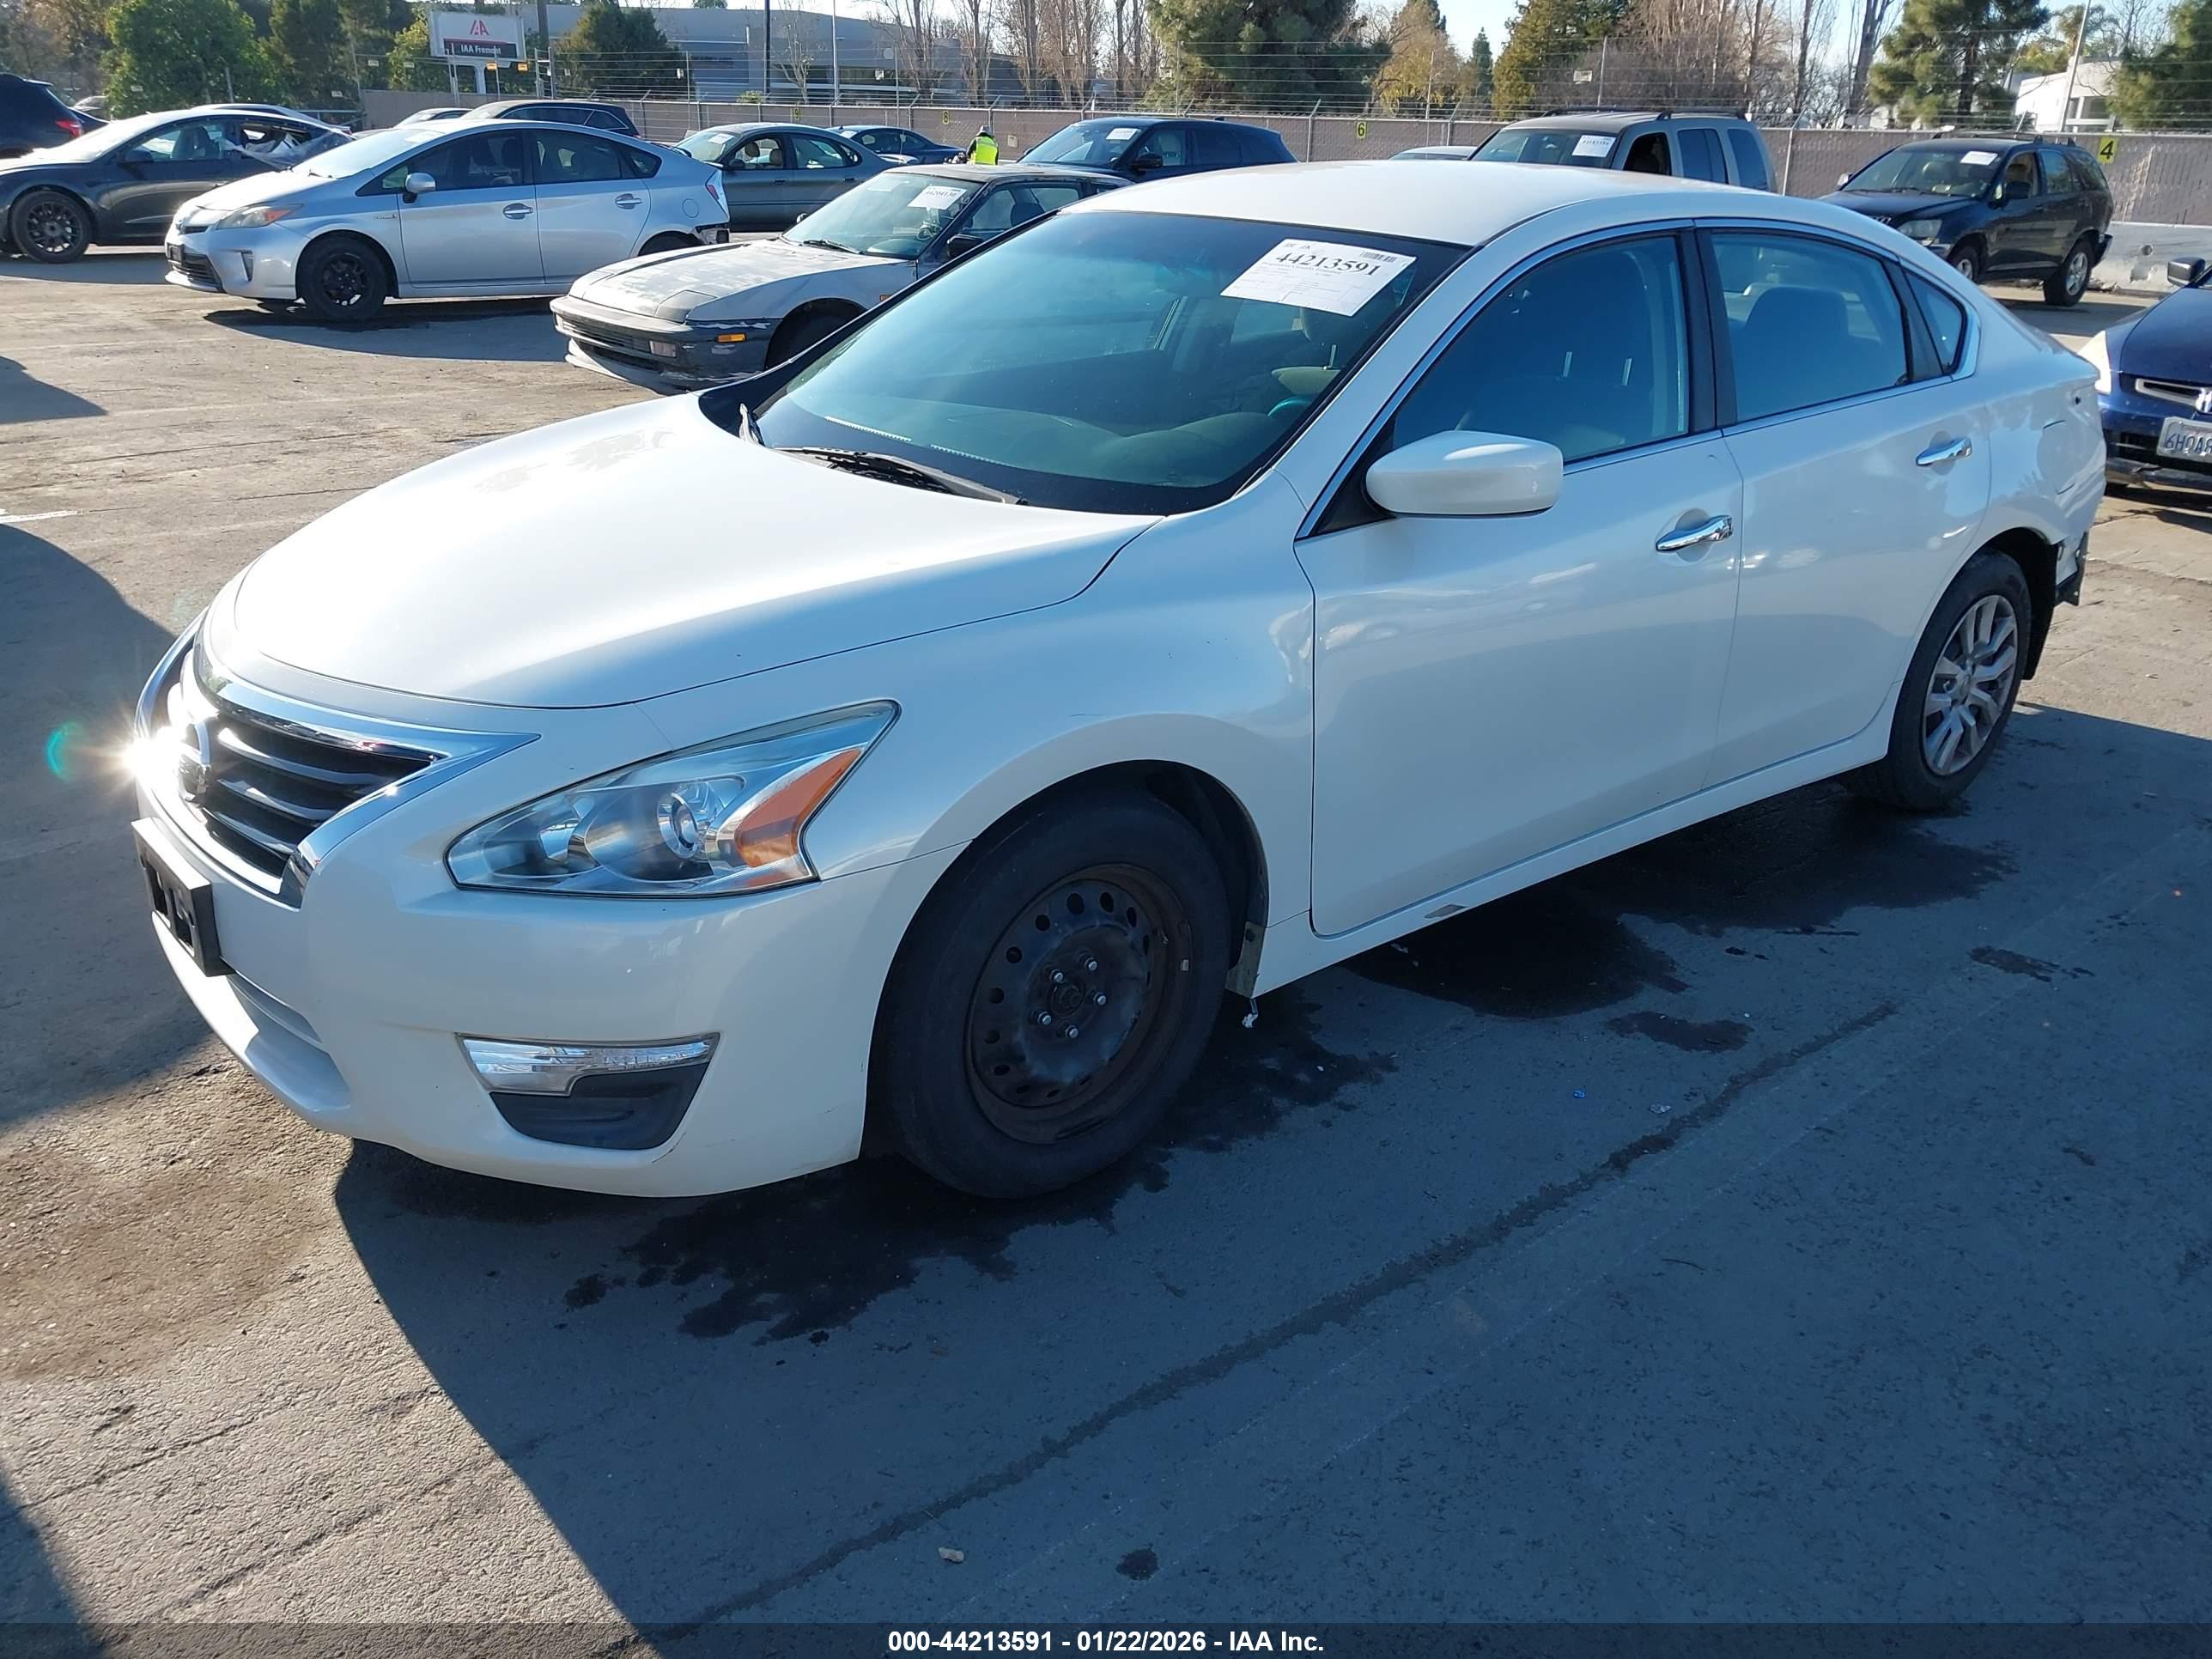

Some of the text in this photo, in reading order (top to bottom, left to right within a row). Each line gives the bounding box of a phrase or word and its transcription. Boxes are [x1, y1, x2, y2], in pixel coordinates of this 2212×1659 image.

[460, 44, 501, 55] IAA Fremont
[943, 112, 948, 123] 8
[1358, 122, 1365, 137] 6
[2100, 141, 2114, 160] 4
[1276, 252, 1382, 276] 44213591
